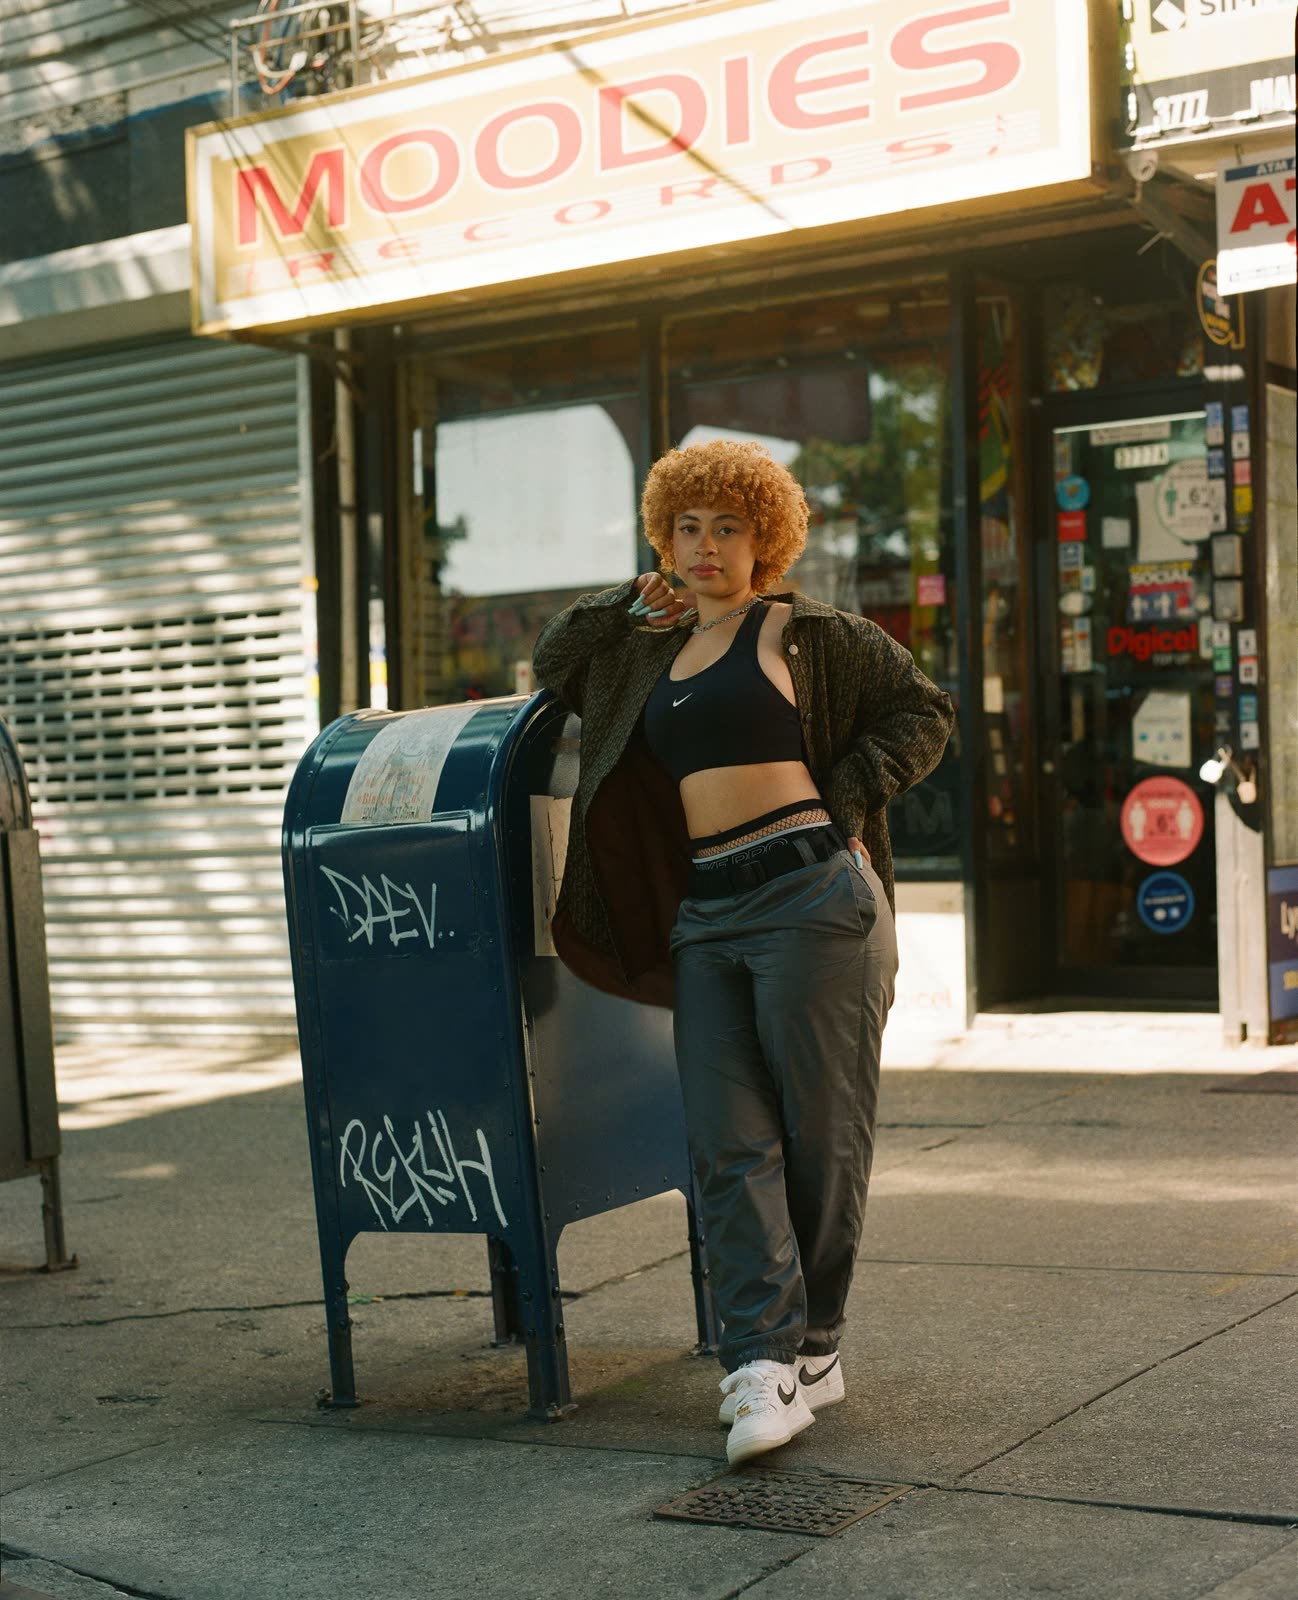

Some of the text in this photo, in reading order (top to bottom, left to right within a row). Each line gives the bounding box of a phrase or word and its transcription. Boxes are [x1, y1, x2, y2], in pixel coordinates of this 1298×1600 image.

[238, 0, 1021, 247] MOODIES
[1256, 161, 1288, 177] ATM
[287, 131, 953, 279] RECORDS
[1107, 623, 1198, 661] Digicel
